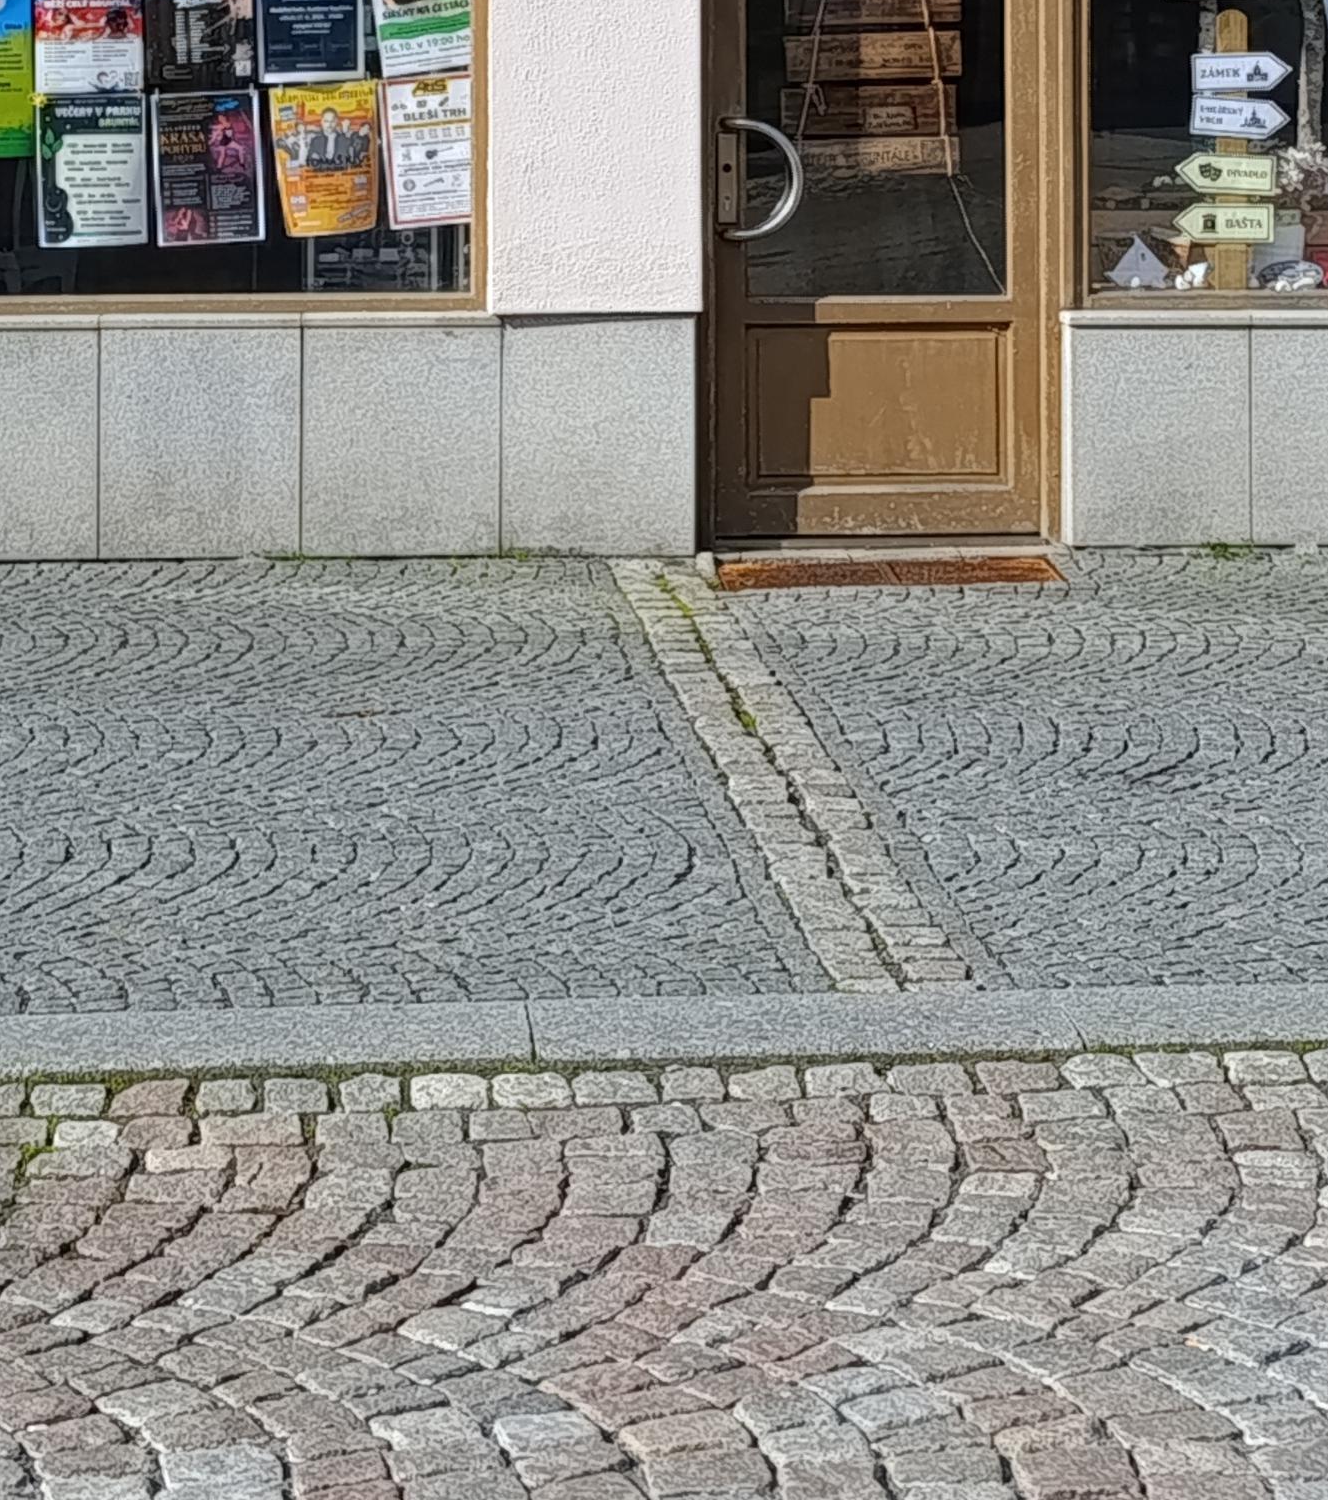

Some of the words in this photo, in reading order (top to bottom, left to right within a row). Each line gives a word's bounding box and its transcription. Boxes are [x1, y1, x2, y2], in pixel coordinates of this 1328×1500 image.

[1200, 66, 1241, 79] ZÁMEK
[403, 109, 438, 122] BLEŠÍ
[442, 108, 467, 119] TRH
[1226, 169, 1268, 179] DIVADLO
[1225, 216, 1263, 229] BAŠTA
